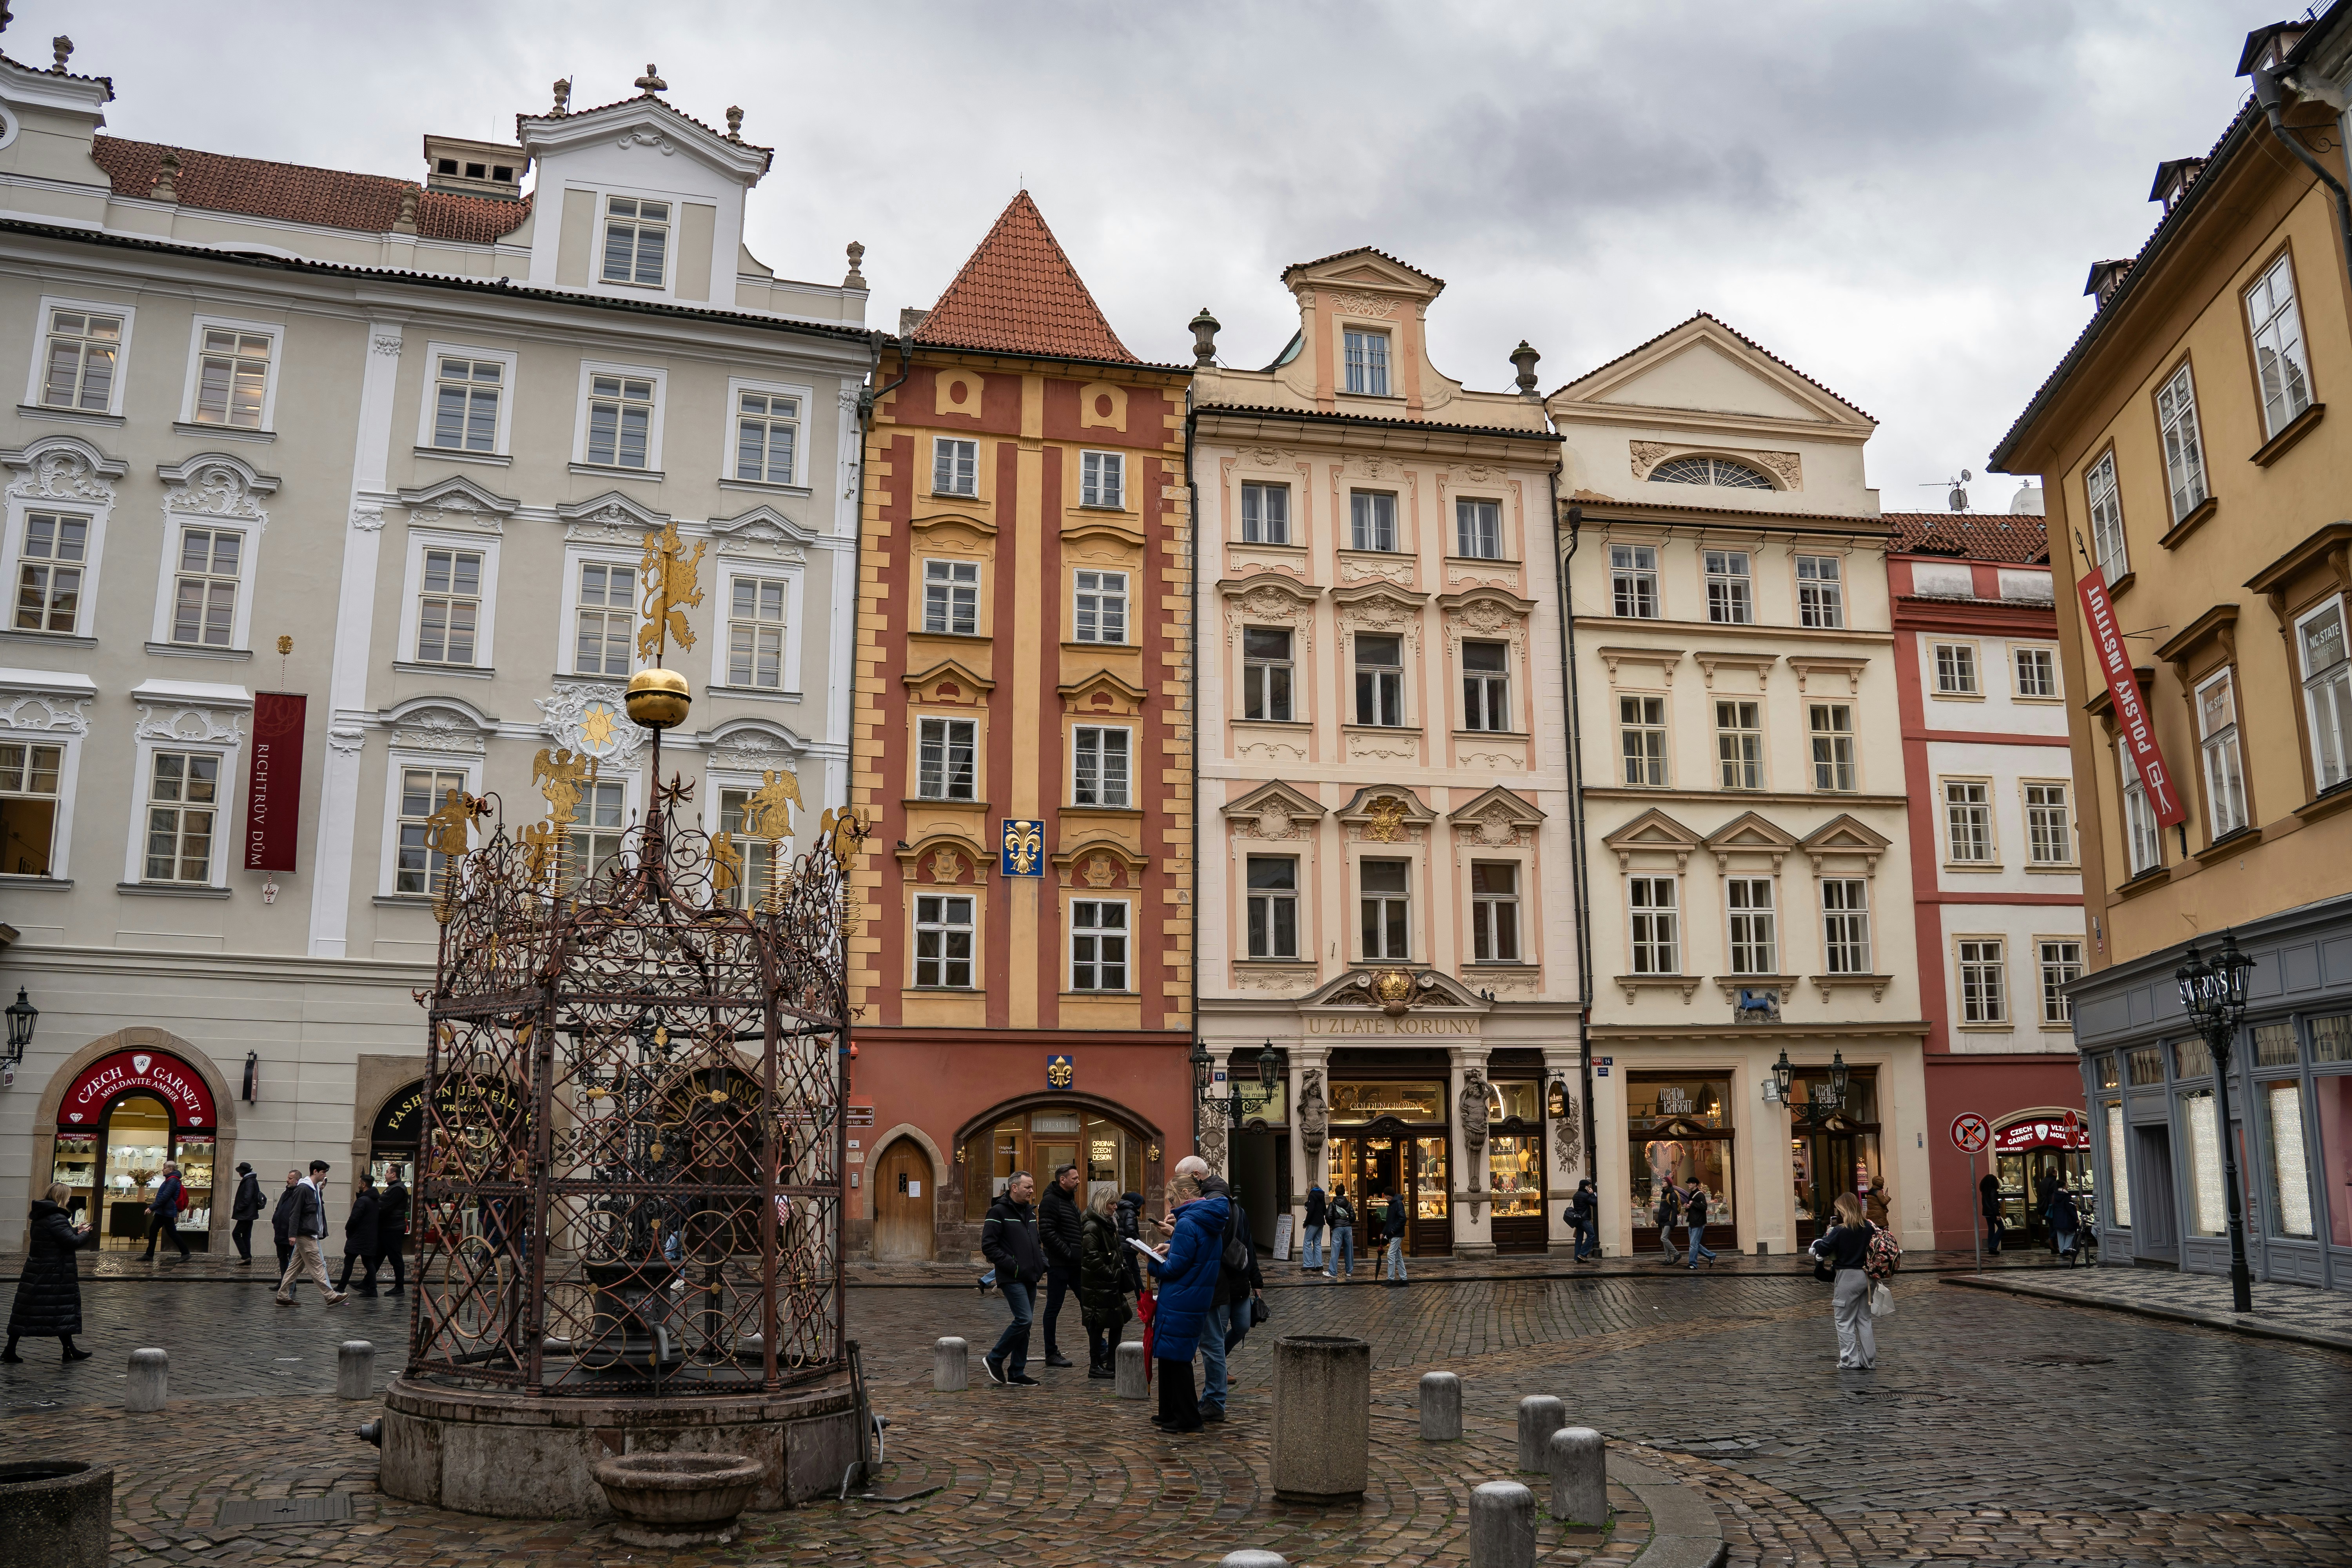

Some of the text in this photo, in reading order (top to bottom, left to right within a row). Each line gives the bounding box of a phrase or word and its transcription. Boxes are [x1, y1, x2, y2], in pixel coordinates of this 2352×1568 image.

[2179, 379, 2185, 392] NC
[2164, 395, 2171, 408] NC
[2178, 387, 2190, 406] STATE
[2163, 404, 2175, 422] STATE
[2309, 622, 2340, 650] NC STATE
[2311, 637, 2341, 662] UNIVERSITY
[2087, 585, 2152, 754] POLSKÝ INSTITUT
[2206, 691, 2229, 714] NC STATE
[2128, 753, 2134, 763] N
[251, 744, 269, 865] RICHTRŮV DŮM
[1309, 1017, 1477, 1034] U ZLATÉ KORUNY
[78, 1066, 201, 1112] CZECH GARNET
[100, 1078, 179, 1103] MOLDAVITE AMBER
[388, 1085, 452, 1130] FASHN
[1664, 1100, 1692, 1113] RABBIT
[2007, 1133, 2033, 1145] GARNET
[2010, 1125, 2033, 1136] CZECH
